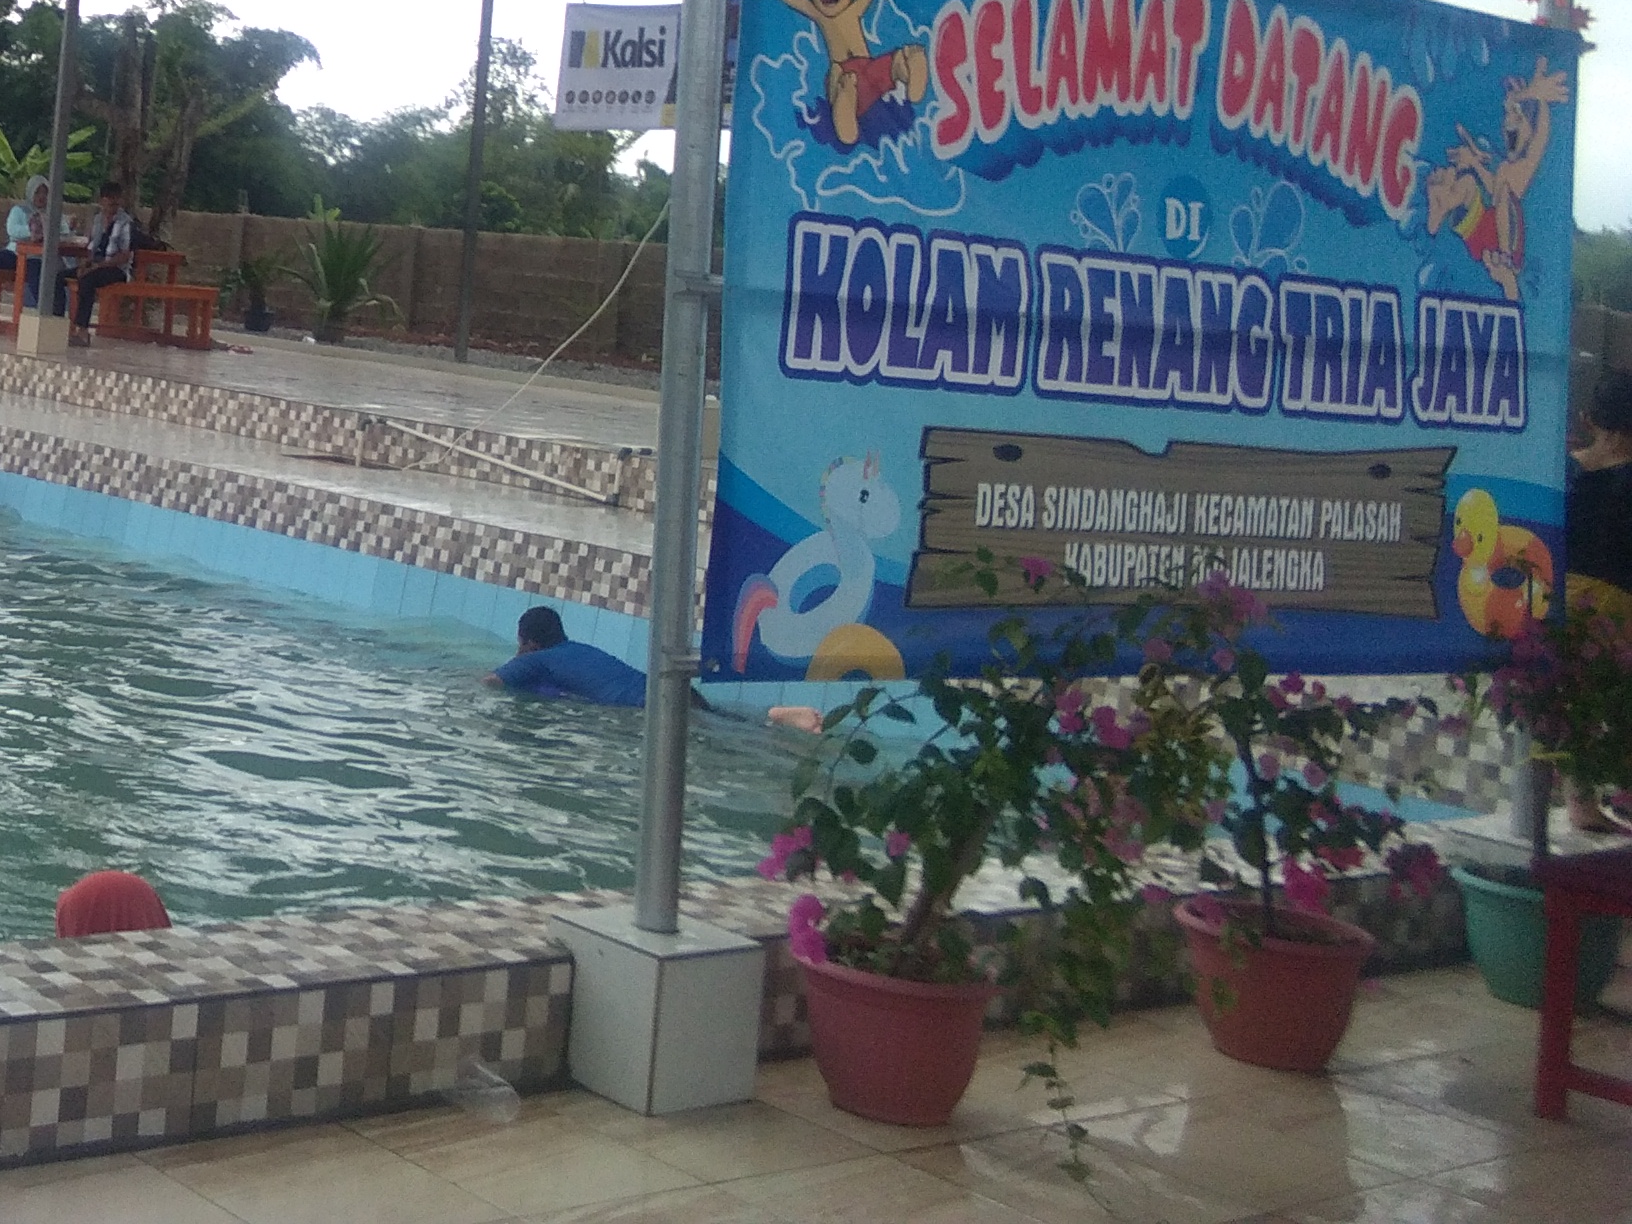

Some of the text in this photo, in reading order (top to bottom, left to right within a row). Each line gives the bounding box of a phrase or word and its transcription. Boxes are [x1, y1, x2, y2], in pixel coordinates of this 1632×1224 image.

[601, 26, 666, 68] Kalsi
[1164, 197, 1204, 241] DI
[786, 220, 1525, 427] KOLAM RENANG TRIA JAYA
[975, 482, 1402, 543] DESA SINDANGHAJI KECAMATAN PALASAH
